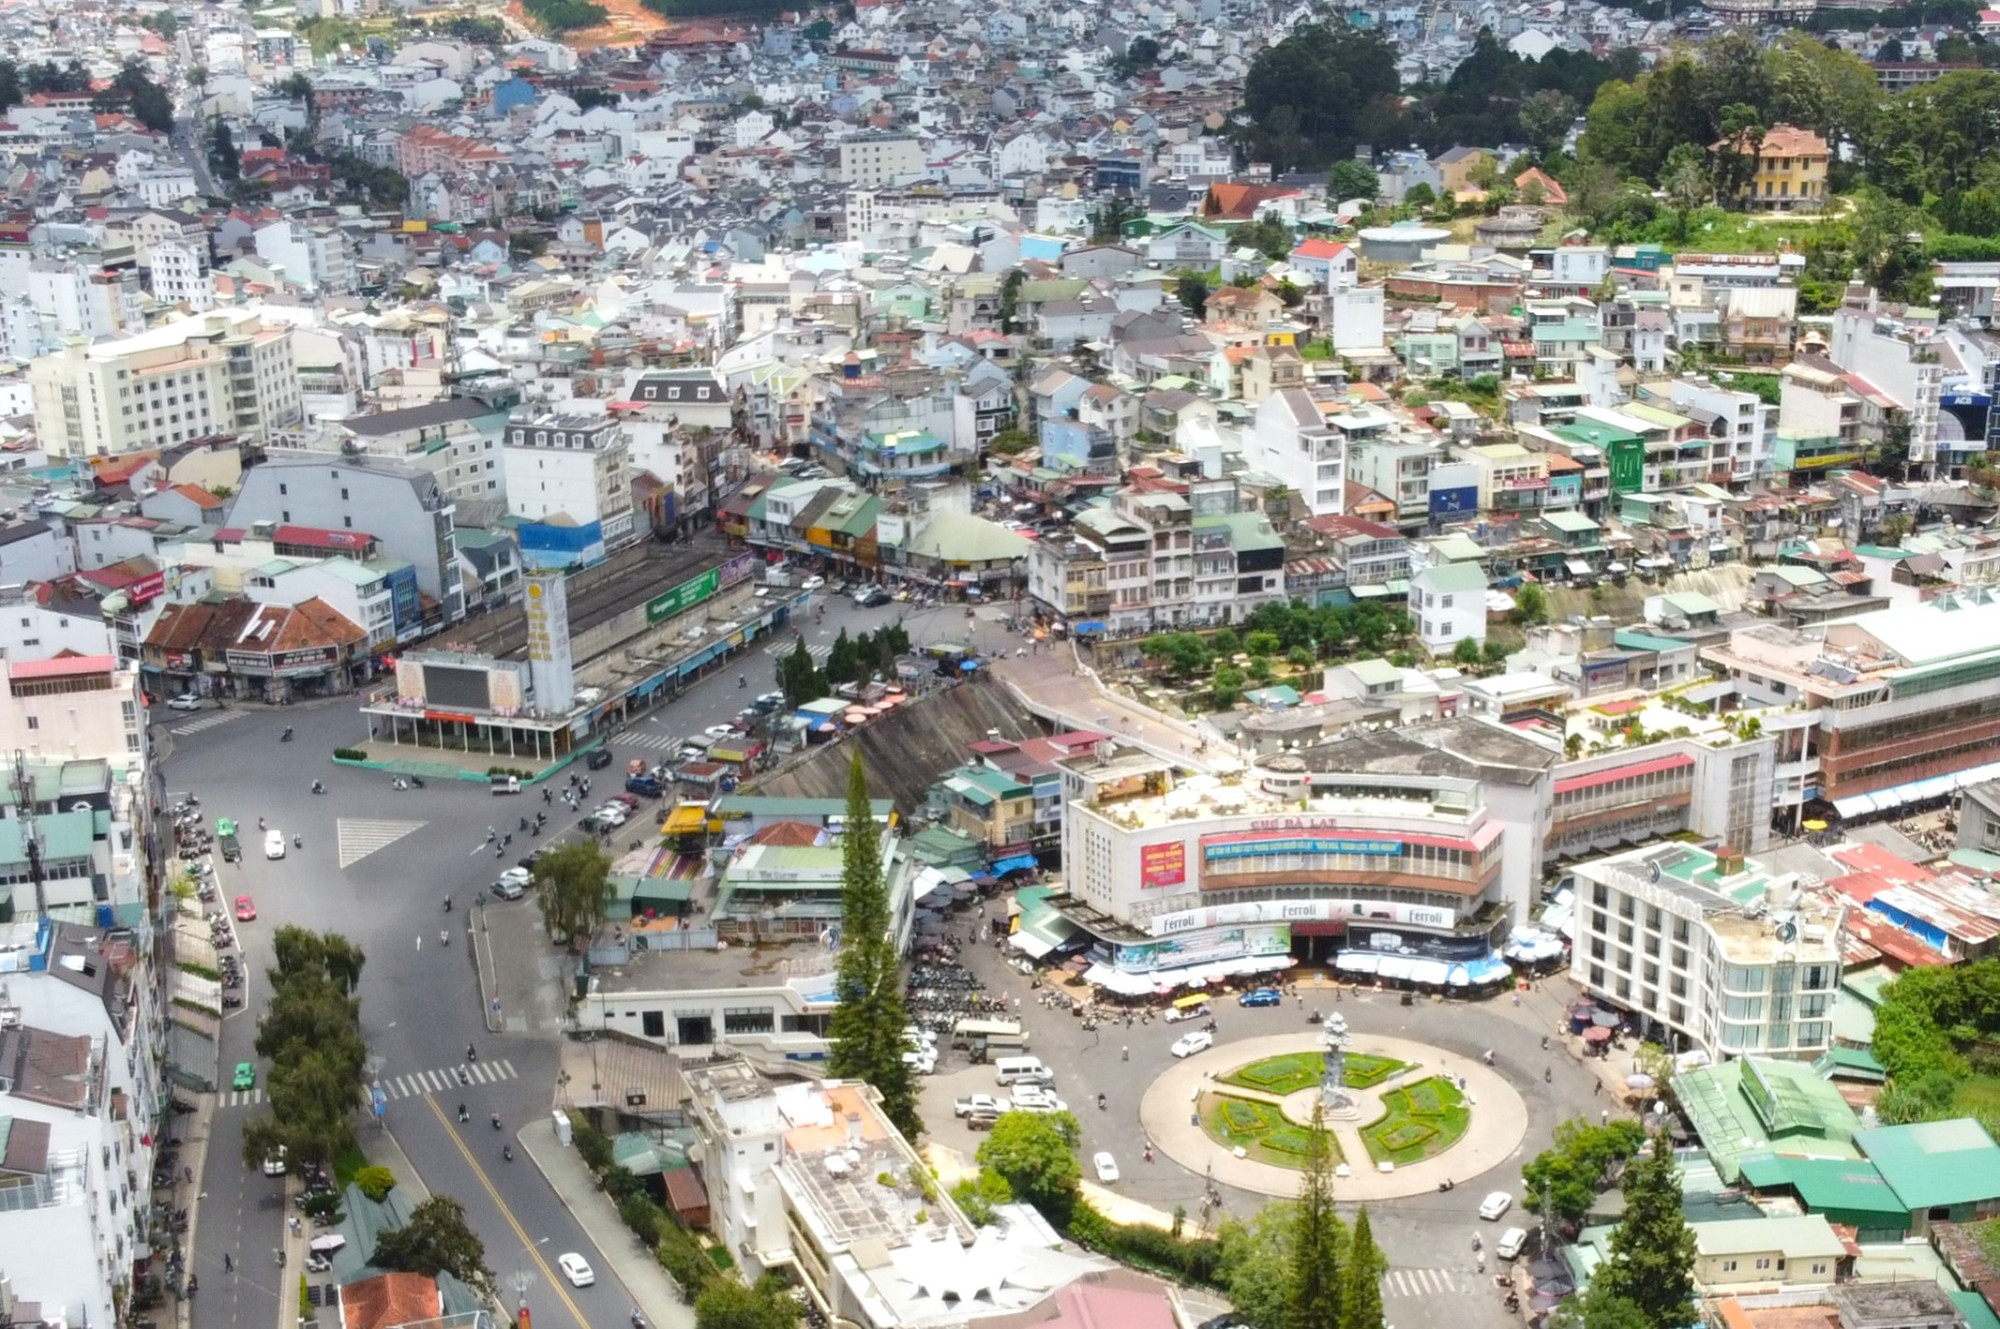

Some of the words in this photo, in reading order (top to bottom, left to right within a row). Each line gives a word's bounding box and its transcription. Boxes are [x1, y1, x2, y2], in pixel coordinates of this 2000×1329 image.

[1954, 396, 1972, 405] ACB
[1282, 904, 1317, 919] Ferroli
[1409, 909, 1443, 925] Ferroli
[1163, 914, 1195, 933] Ferroli
